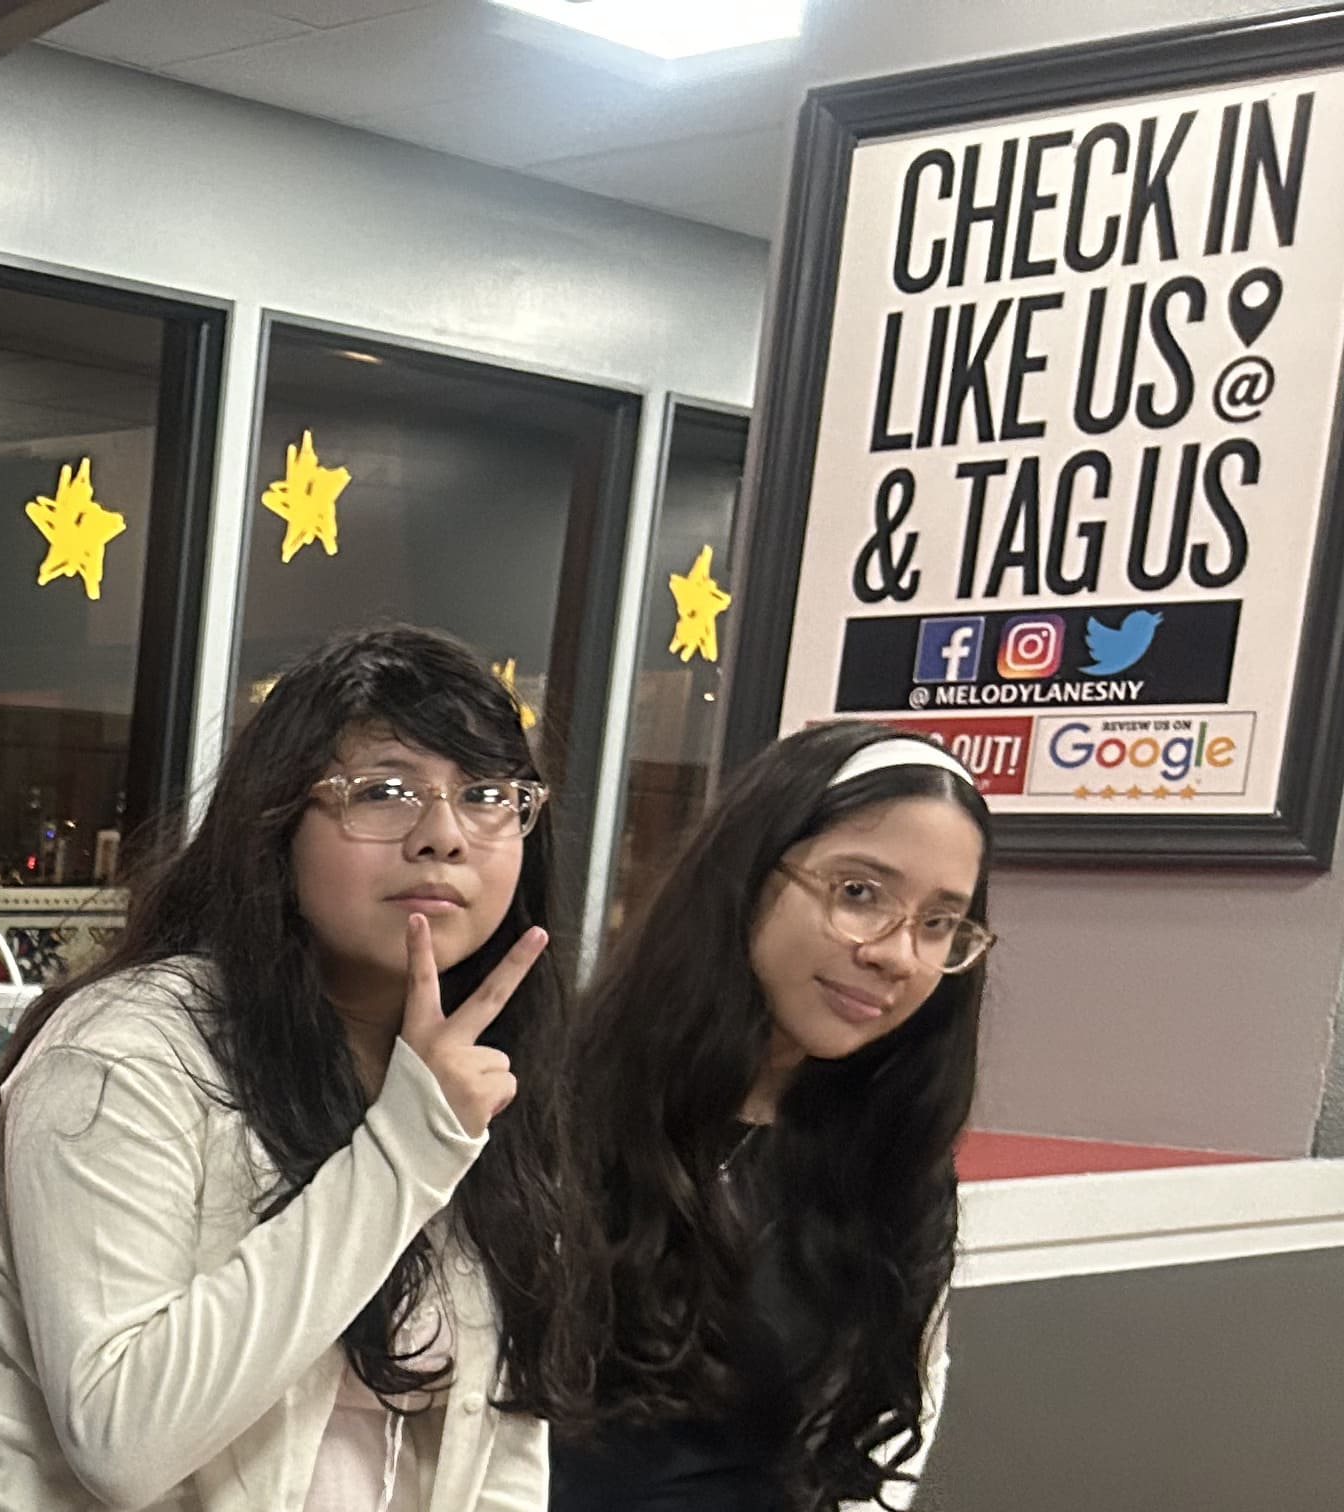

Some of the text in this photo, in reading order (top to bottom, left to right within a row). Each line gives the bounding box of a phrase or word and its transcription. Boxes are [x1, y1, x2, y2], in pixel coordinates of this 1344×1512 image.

[892, 91, 1315, 294] CHECK IN
[870, 276, 1206, 453] LIKE US
[1213, 356, 1275, 423] @
[853, 438, 1260, 604] & TAG US
[909, 681, 1144, 710] @ MELODYLANESNY
[1102, 720, 1151, 731] REVIEW
[1173, 720, 1192, 730] ON
[1049, 720, 1236, 782] Google
